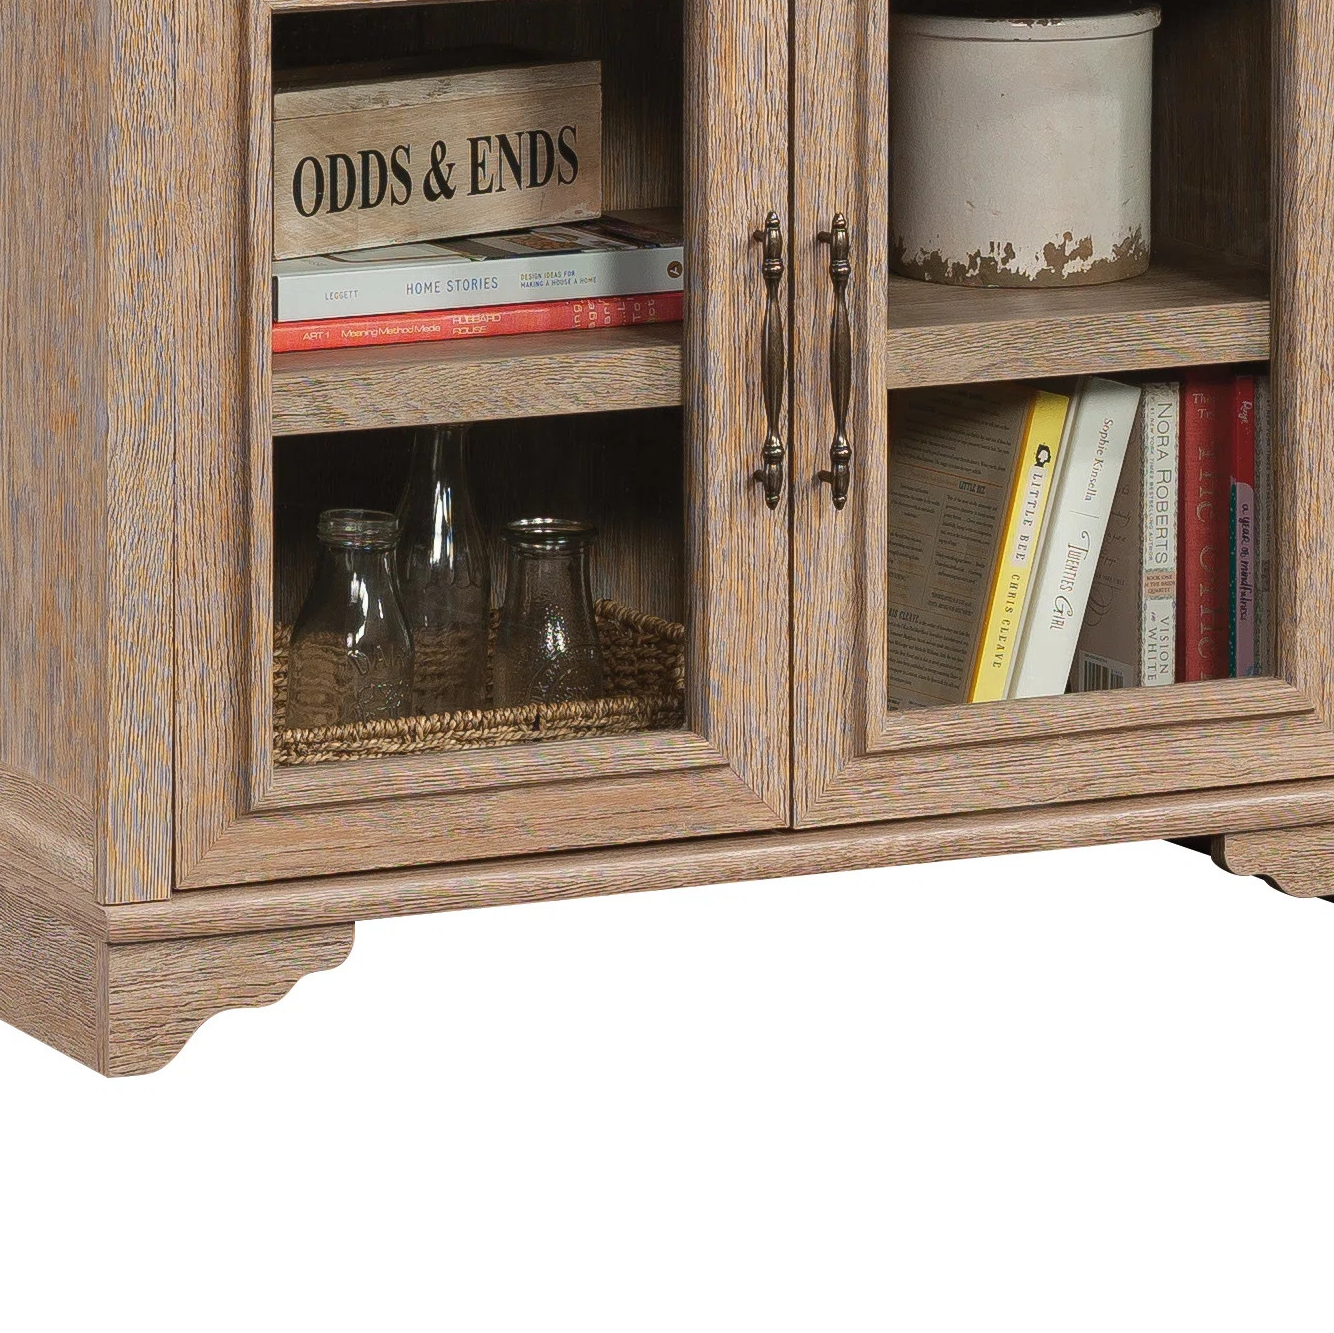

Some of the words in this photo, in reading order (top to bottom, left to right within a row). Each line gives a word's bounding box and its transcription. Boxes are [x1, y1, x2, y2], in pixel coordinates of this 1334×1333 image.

[292, 144, 413, 218] ODDS
[422, 140, 457, 202] &
[467, 124, 580, 197] ENDS
[324, 289, 359, 301] LEGGETT
[406, 280, 441, 296] HOME
[446, 276, 499, 293] STORIES
[520, 272, 543, 281] DESIGN
[543, 270, 563, 279] IDEAS
[563, 269, 576, 278] FOR
[520, 279, 545, 289] MAKING
[551, 277, 574, 287] HOUSE
[302, 331, 326, 341] ART
[1096, 417, 1113, 456] Sophie
[1156, 402, 1173, 462] NORA
[1022, 472, 1043, 527] LITTLE
[1084, 457, 1104, 502] Kinsella
[1155, 469, 1173, 564] ROBERTS
[1015, 534, 1030, 561] BEE
[1005, 573, 1021, 613] CHRIS
[992, 619, 1011, 669] CLEAVE
[1147, 627, 1158, 681] WHITE
[1160, 615, 1170, 674] VISION
